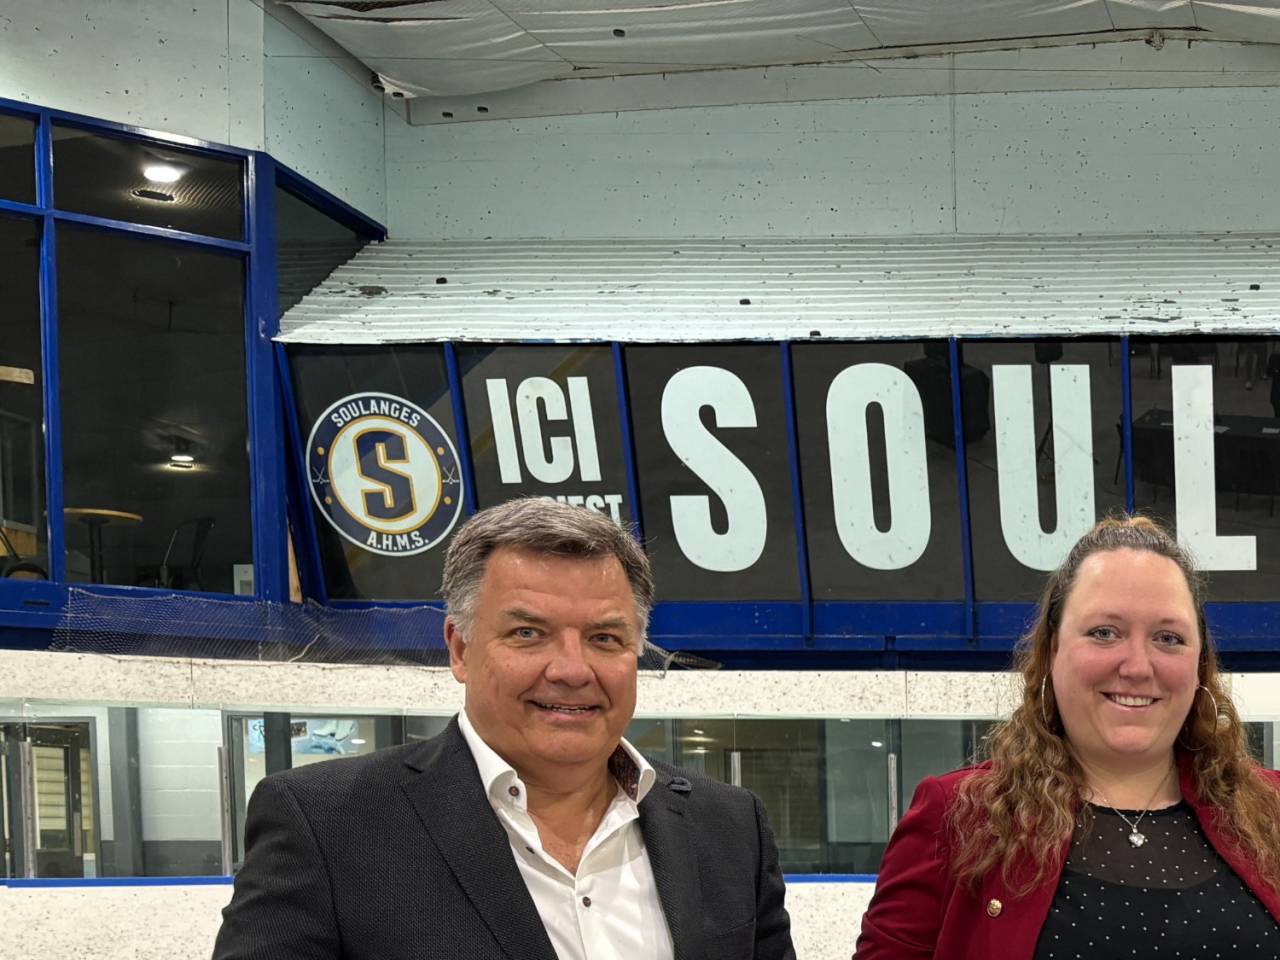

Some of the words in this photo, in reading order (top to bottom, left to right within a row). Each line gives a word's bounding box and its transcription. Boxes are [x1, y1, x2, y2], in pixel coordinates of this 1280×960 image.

[331, 400, 421, 428] SOULANGES
[486, 376, 601, 484] ICI
[352, 427, 418, 523] S
[367, 530, 429, 552] A.H.M.S.
